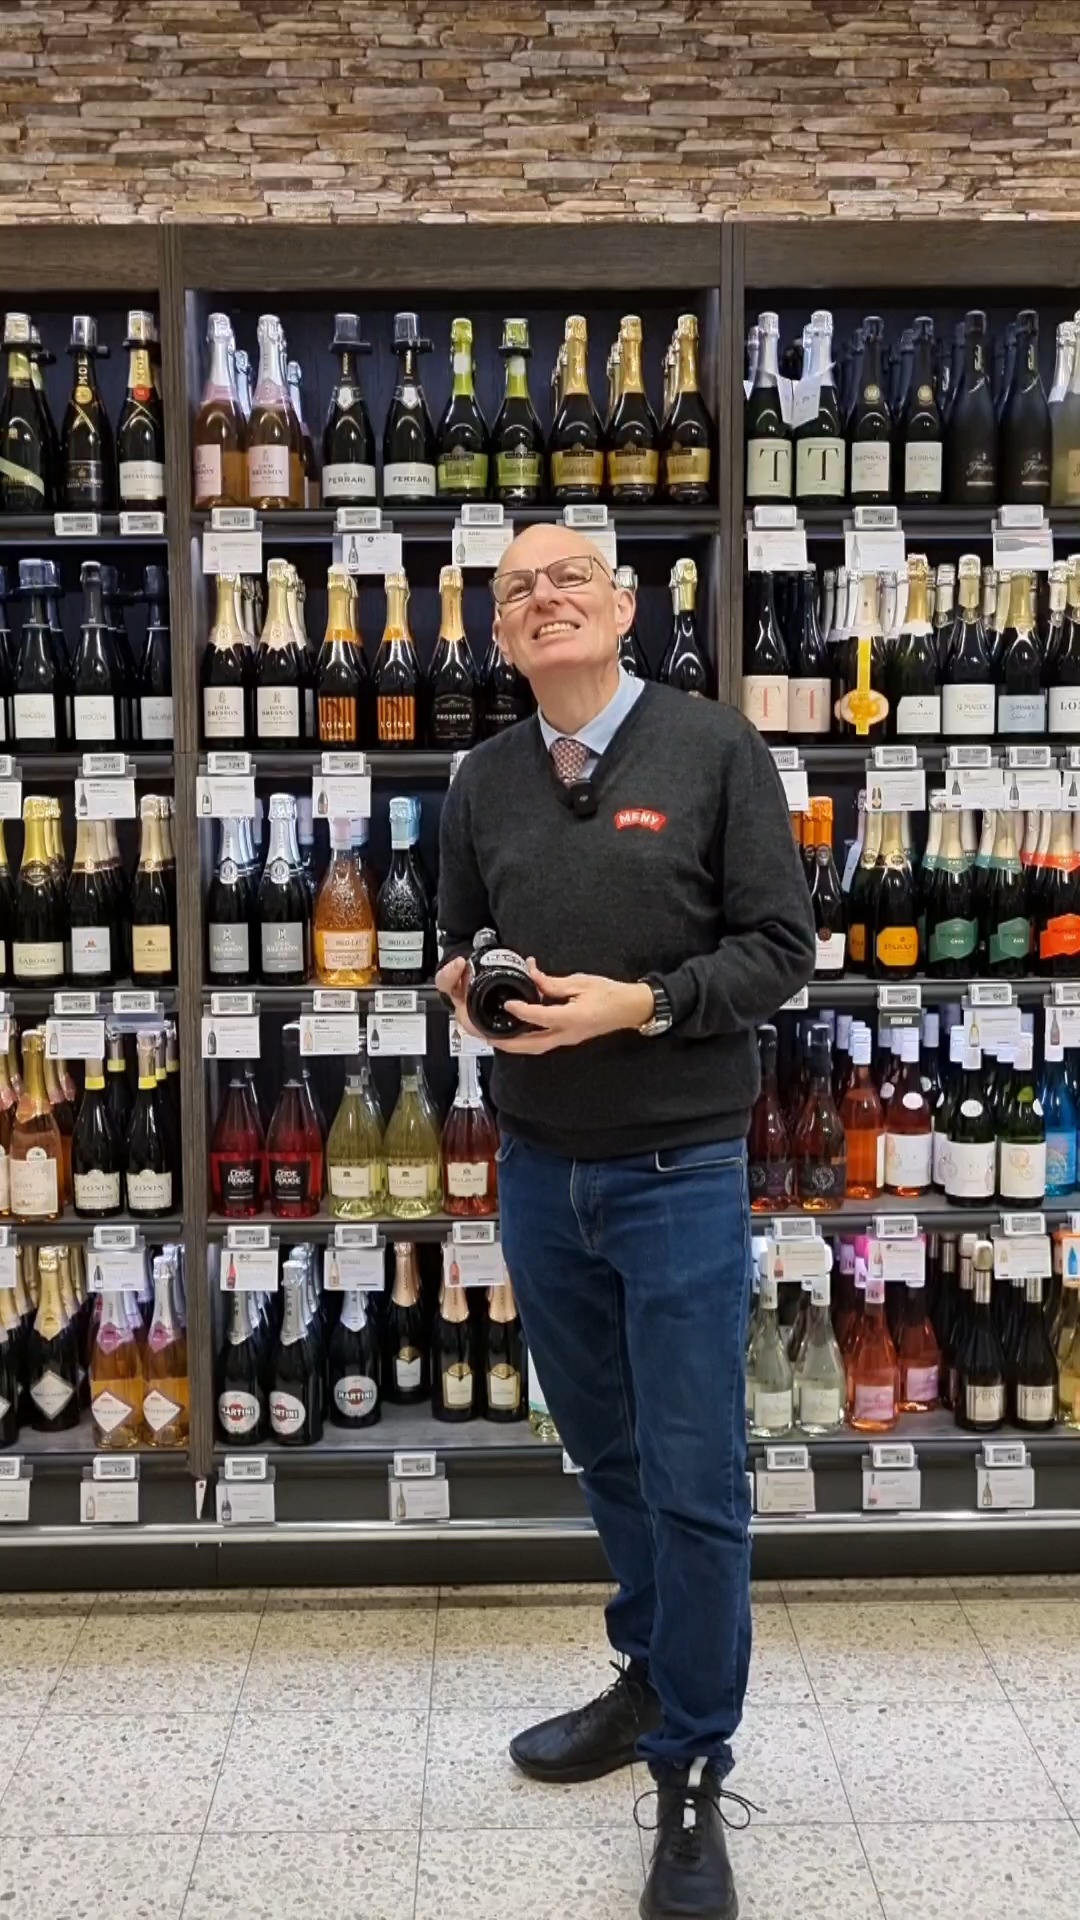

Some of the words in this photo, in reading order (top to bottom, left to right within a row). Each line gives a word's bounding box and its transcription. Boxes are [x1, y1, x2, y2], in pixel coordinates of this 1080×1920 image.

[807, 447, 839, 481] T
[328, 475, 366, 484] FERRARI
[392, 475, 430, 484] FERRARI
[619, 811, 660, 825] MENY
[229, 1169, 252, 1178] CODE
[276, 1169, 297, 1178] CODE
[227, 1175, 254, 1186] ROUGE
[275, 1175, 301, 1186] ROUGE
[338, 1391, 374, 1400] MARTINI
